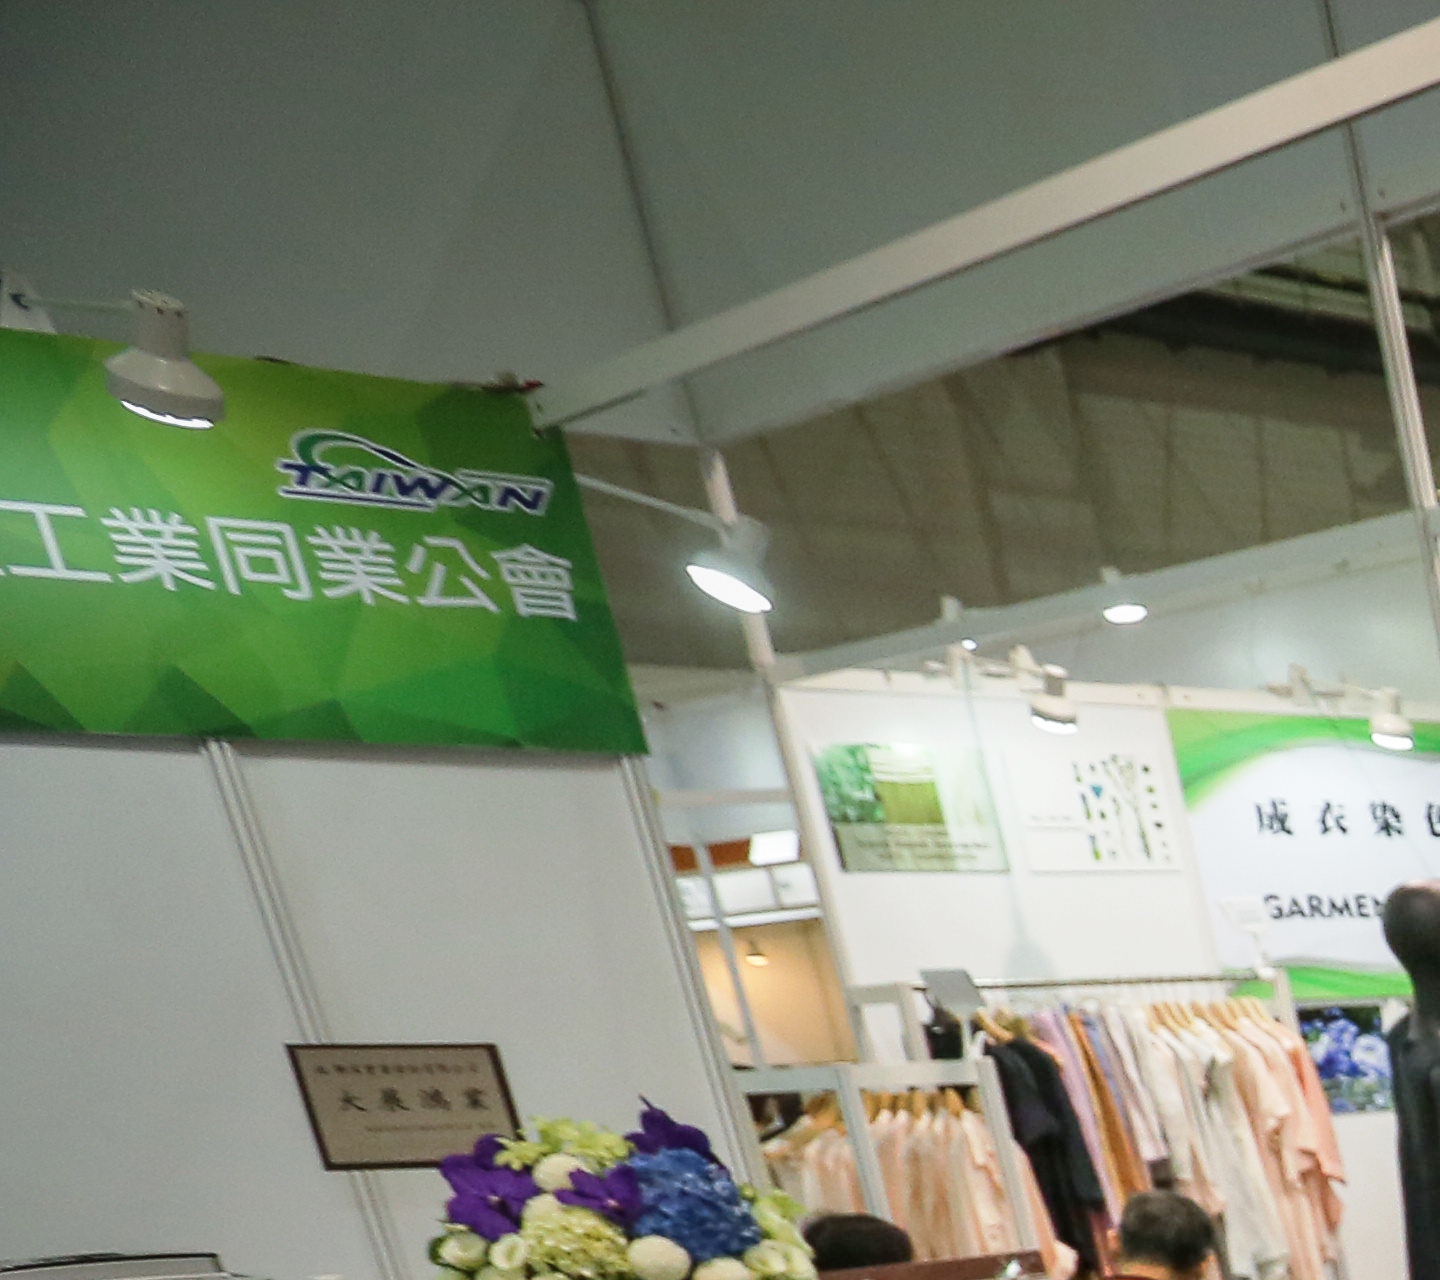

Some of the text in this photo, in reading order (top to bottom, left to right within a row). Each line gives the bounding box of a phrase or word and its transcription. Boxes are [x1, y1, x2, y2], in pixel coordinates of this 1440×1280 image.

[279, 450, 553, 515] TAIWAN
[8, 501, 578, 622] 工業同業公會
